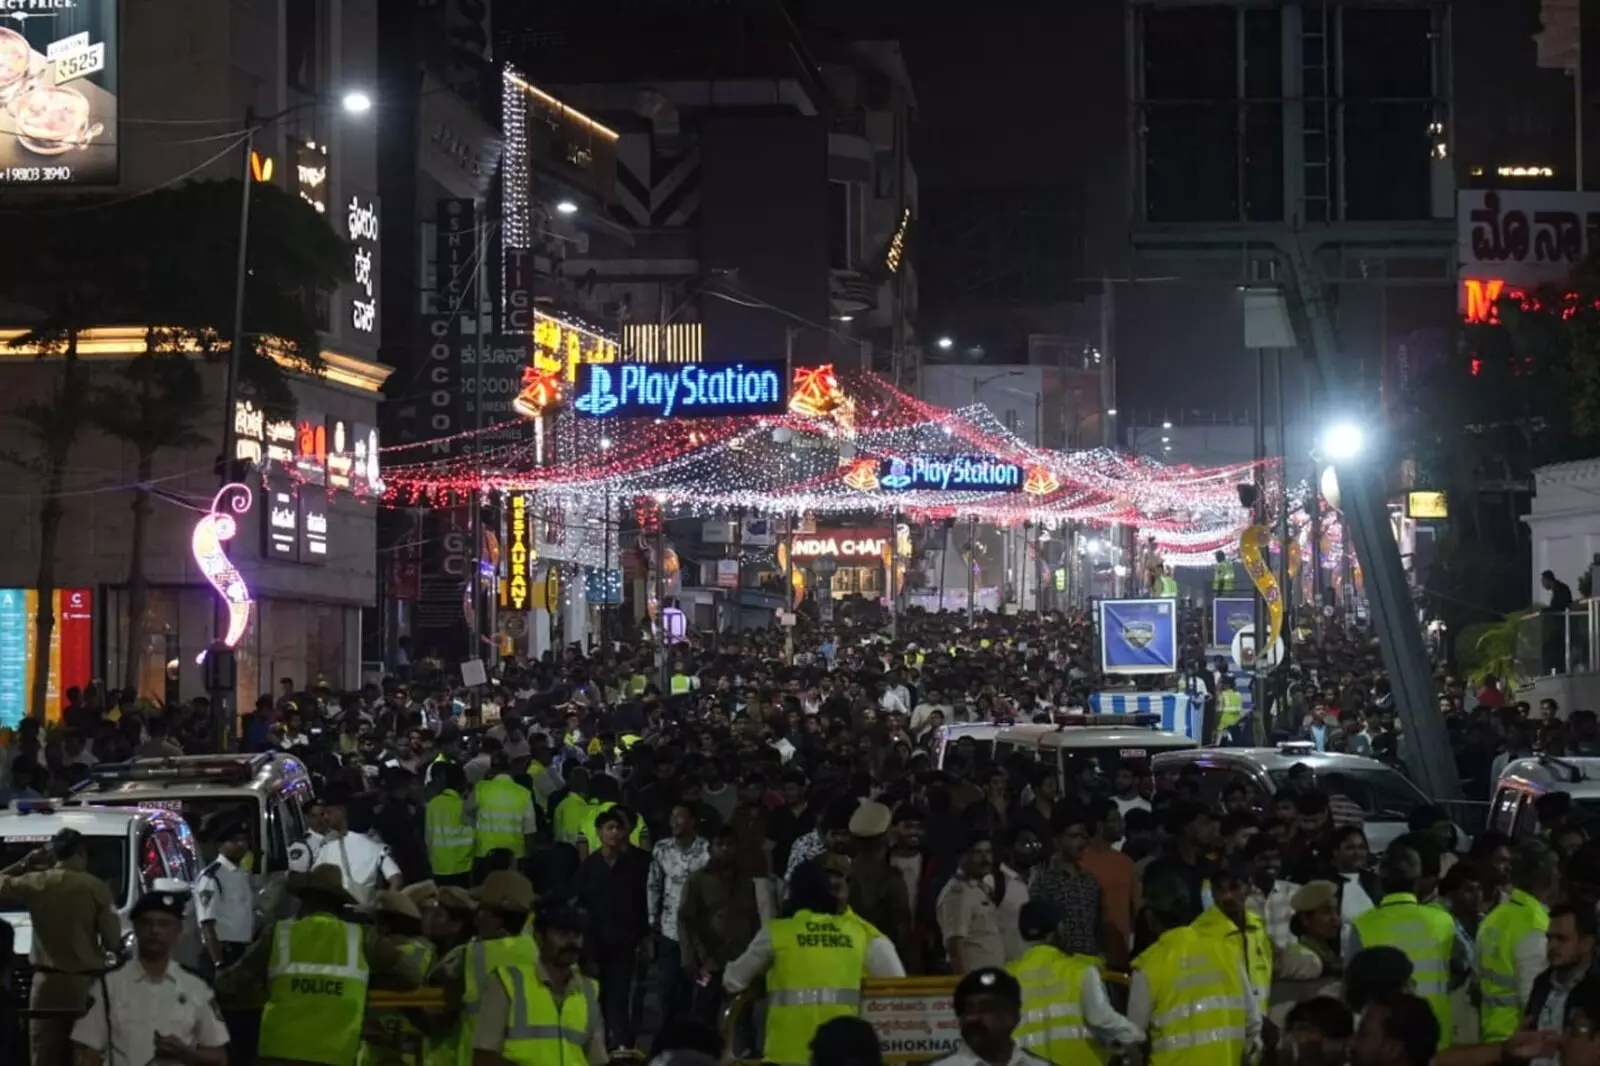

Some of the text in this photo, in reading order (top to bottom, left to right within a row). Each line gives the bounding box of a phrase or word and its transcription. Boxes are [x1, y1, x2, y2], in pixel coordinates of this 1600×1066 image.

[509, 250, 529, 328] TIGC
[430, 320, 450, 454] COCOON
[621, 364, 778, 416] PlayStation
[911, 456, 1018, 489] PlayStation
[510, 495, 528, 610] RESTAURANT
[791, 538, 839, 556] INDIA
[797, 934, 853, 949] DEFENCE
[291, 978, 344, 997] POLICE
